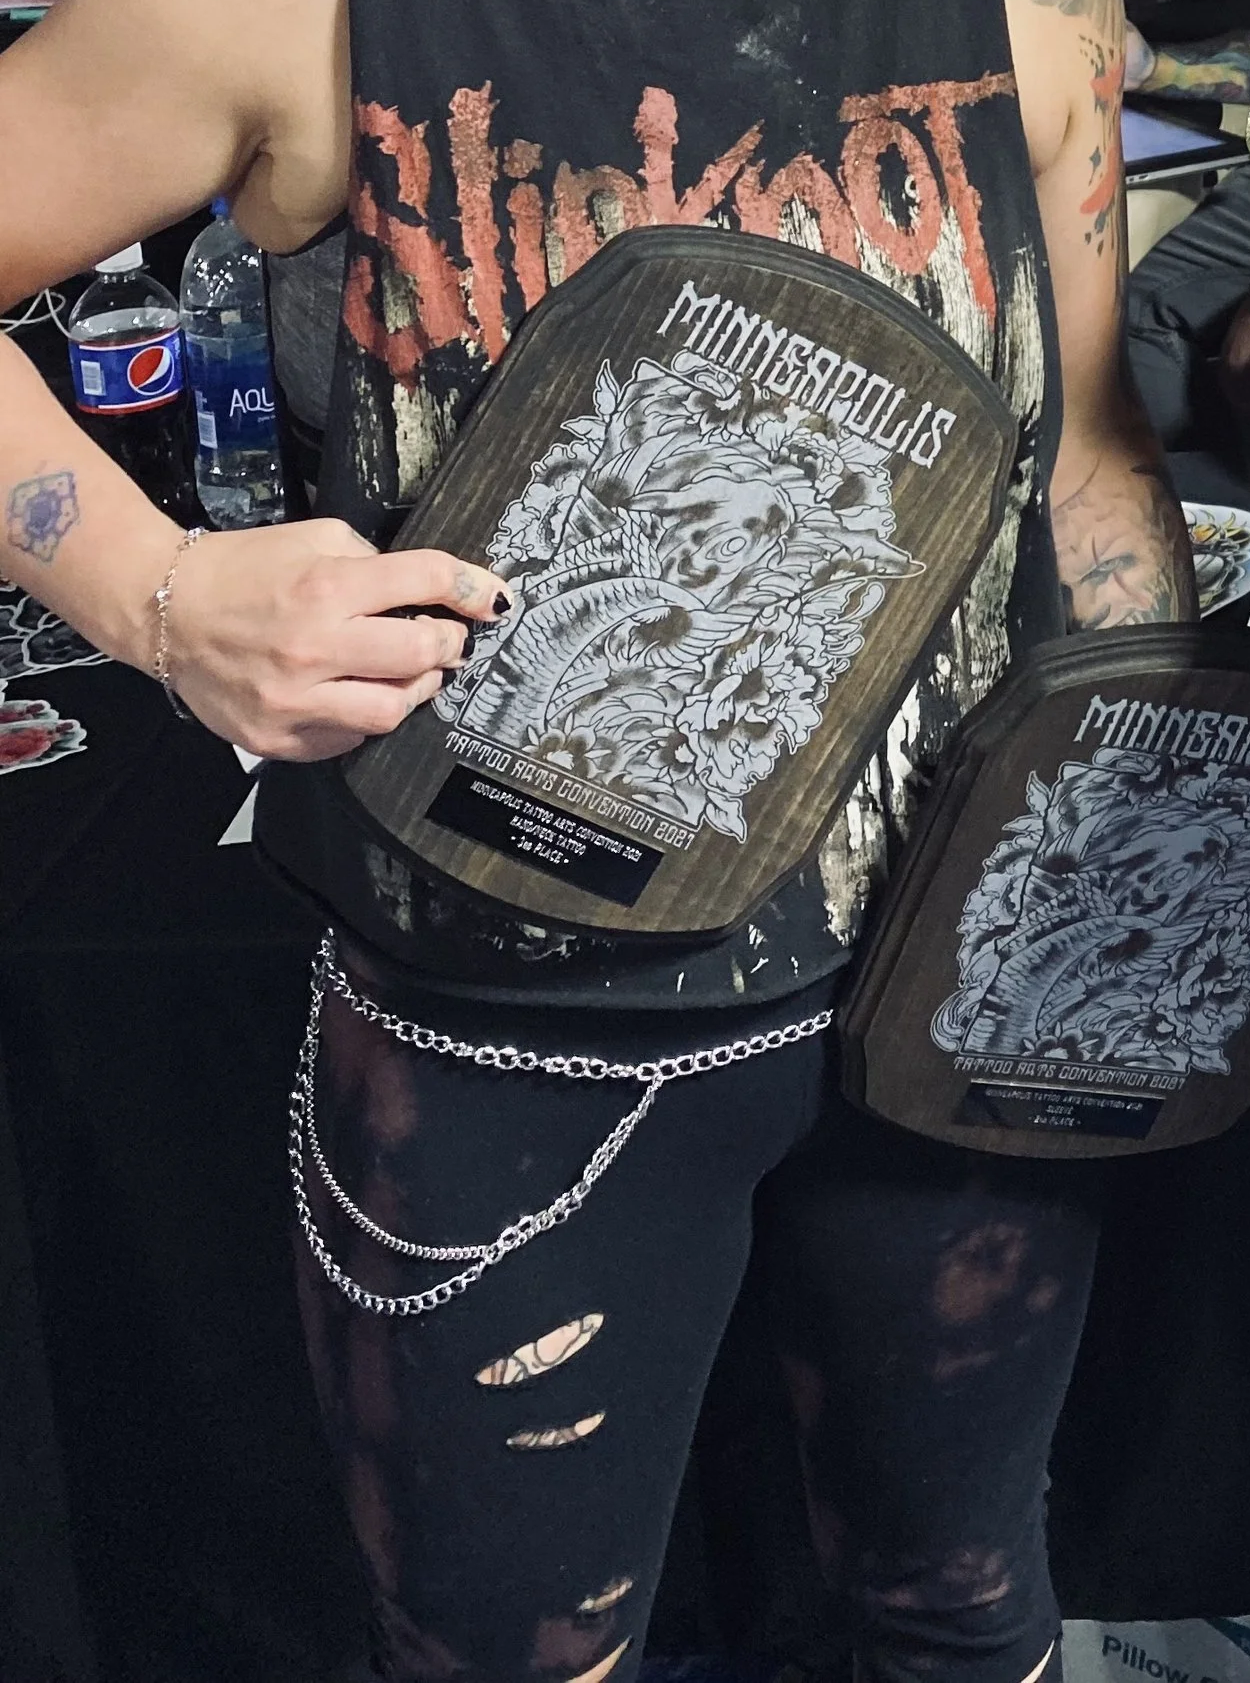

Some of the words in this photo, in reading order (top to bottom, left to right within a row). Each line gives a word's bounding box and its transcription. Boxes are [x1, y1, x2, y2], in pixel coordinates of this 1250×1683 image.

[656, 279, 958, 470] MINNEAPOLIS
[445, 730, 511, 773] TATTOO
[511, 760, 559, 790] ARTS
[557, 774, 652, 834] CONVENTION
[533, 842, 565, 865] PLACE
[953, 1055, 1015, 1075] TATTOO
[1015, 1062, 1057, 1079] ARTS
[1058, 1065, 1150, 1088] CONVENTION
